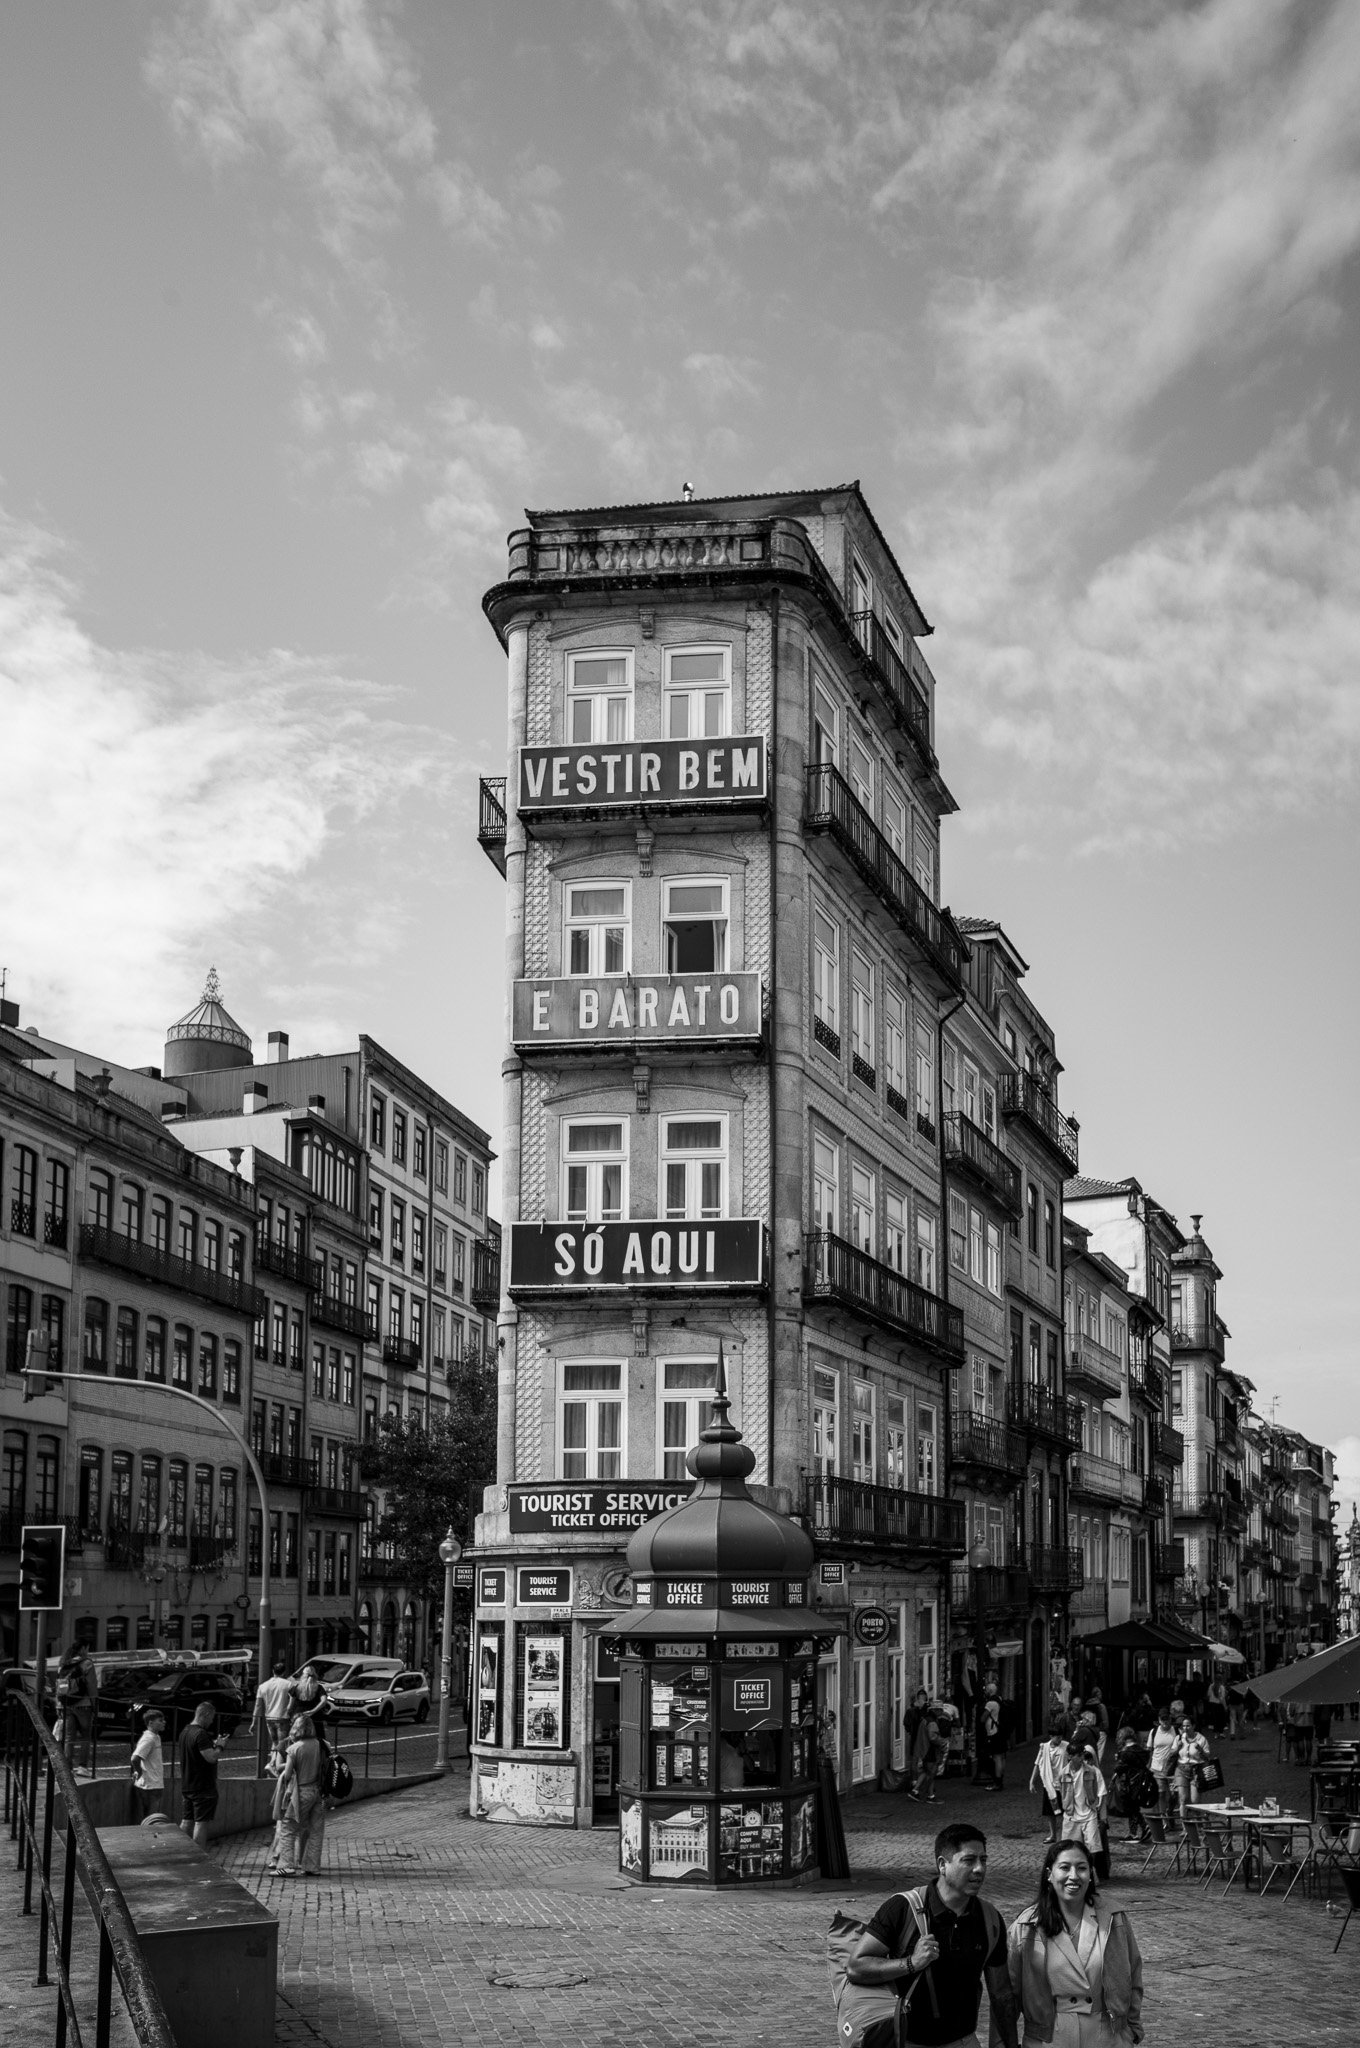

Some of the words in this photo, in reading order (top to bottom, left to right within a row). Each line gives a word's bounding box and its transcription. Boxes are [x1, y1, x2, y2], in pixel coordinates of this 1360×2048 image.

[524, 752, 662, 798] VESTIR
[679, 747, 758, 790] BEM
[532, 989, 550, 1031] E
[578, 984, 739, 1029] BARATO
[554, 1225, 606, 1276] SÓ
[622, 1231, 715, 1275] AQUI
[519, 1493, 593, 1513] TOURIST
[550, 1514, 596, 1526] TICKET
[600, 1513, 648, 1526] OFFICE
[484, 1578, 498, 1586] TICKET
[529, 1576, 557, 1585] TOURIST
[484, 1588, 497, 1596] OFFICE
[529, 1588, 557, 1596] SERVICE
[667, 1583, 703, 1593] TICKET
[731, 1583, 770, 1593] TOURIST
[788, 1583, 802, 1592] TICKET
[666, 1594, 703, 1604] OFFICE
[732, 1594, 769, 1604] SERVICE
[788, 1594, 802, 1603] OFFICE
[862, 1618, 883, 1626] PORTO
[741, 1683, 764, 1691] TICKET
[740, 1691, 764, 1699] OFFICE
